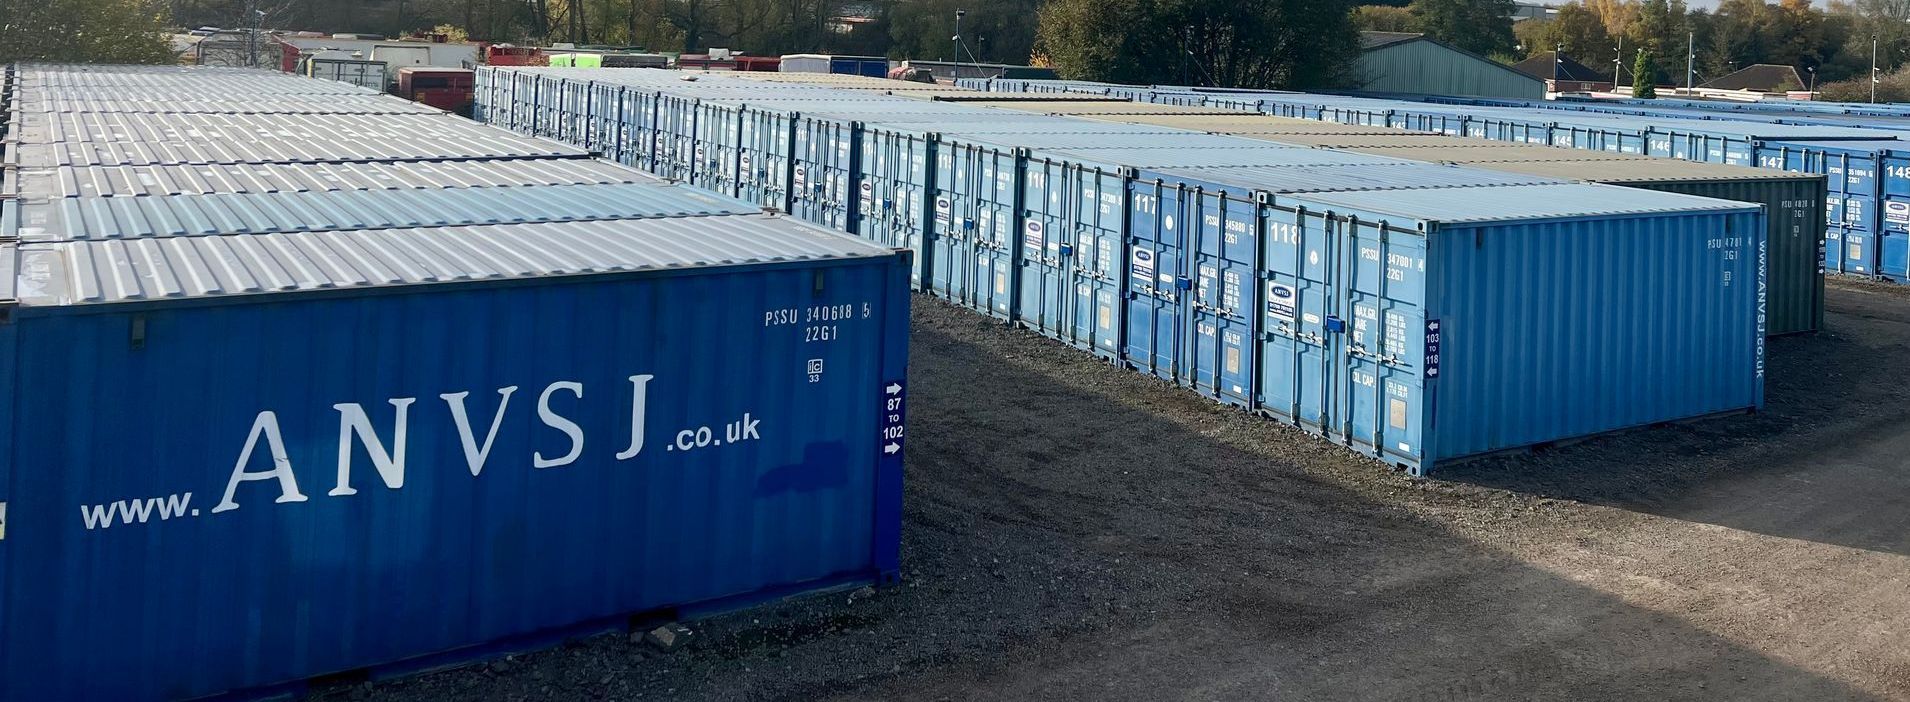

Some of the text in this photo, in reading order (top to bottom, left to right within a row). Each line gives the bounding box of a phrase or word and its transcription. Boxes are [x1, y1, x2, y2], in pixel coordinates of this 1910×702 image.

[1271, 222, 1301, 244] 118
[765, 302, 871, 326] PSSU 340688 5
[805, 325, 837, 342] 22G1
[1426, 333, 1439, 344] 103
[1425, 354, 1439, 365] 118
[809, 374, 820, 383] 33
[887, 398, 902, 411] 87
[888, 414, 900, 423] TO
[883, 425, 904, 440] 102
